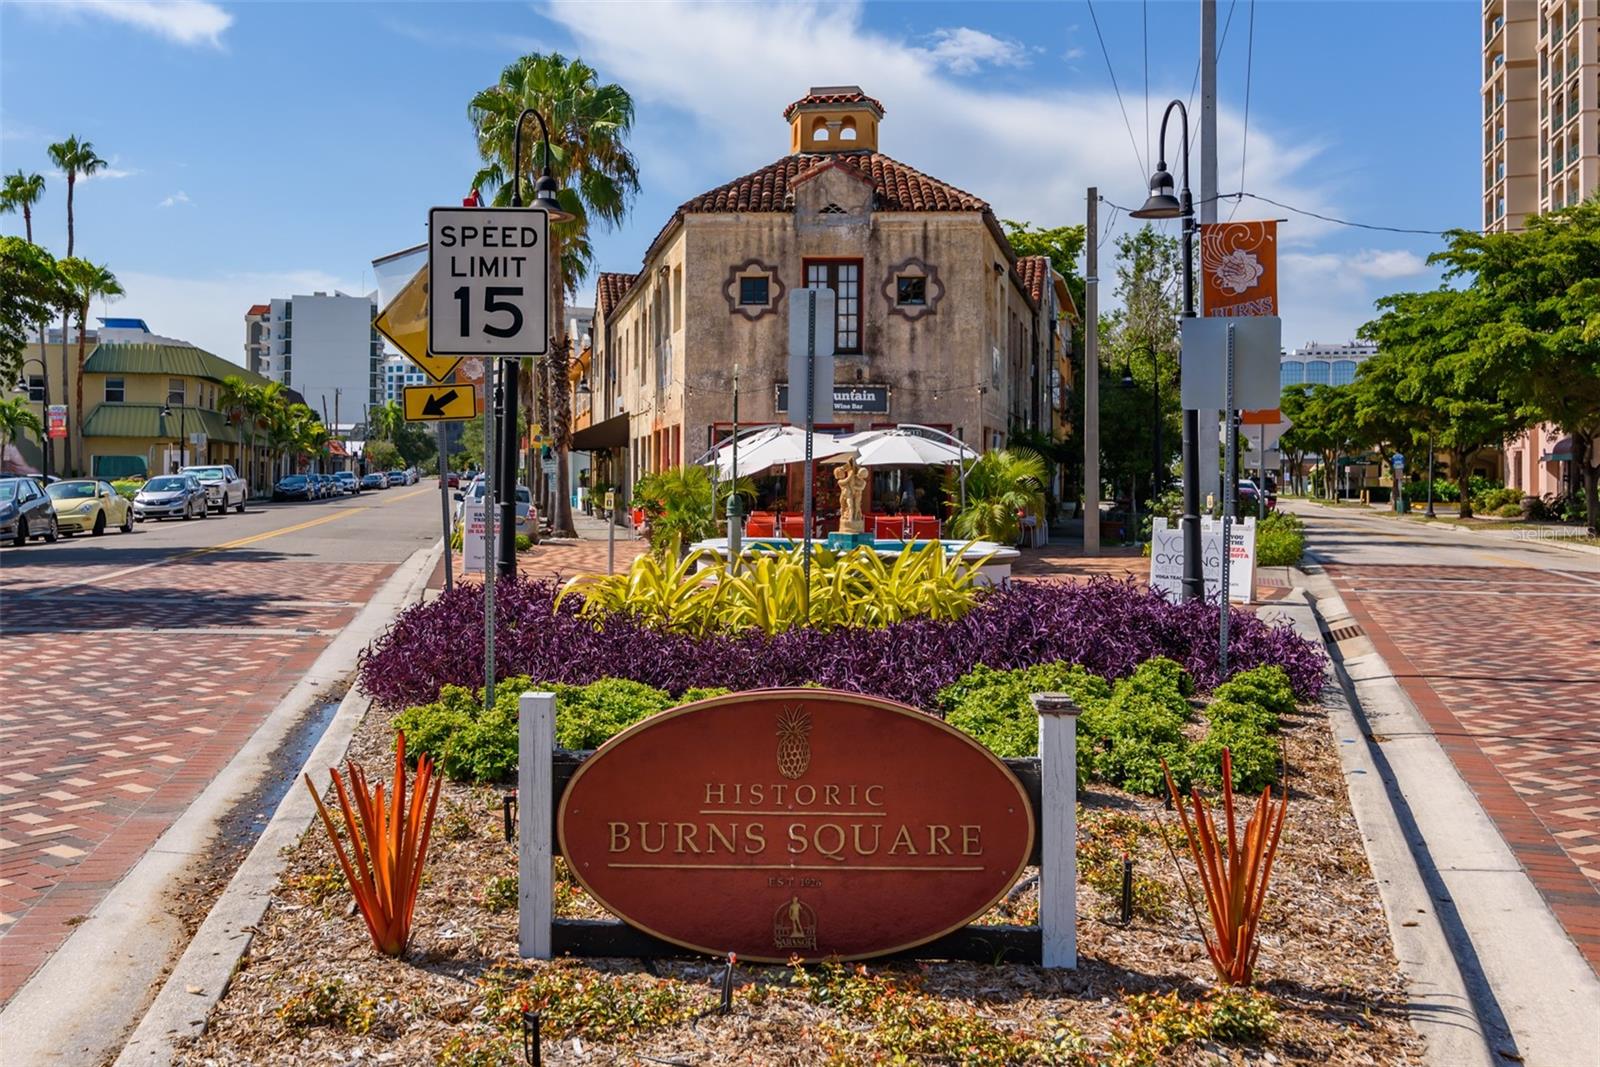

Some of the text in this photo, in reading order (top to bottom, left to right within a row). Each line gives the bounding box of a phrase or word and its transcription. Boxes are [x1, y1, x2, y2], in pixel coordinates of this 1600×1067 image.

[440, 226, 538, 248] SPEED
[451, 256, 527, 278] LIMIT
[454, 286, 524, 339] 15
[833, 390, 876, 401] untain
[1157, 536, 1220, 554] YOA
[1155, 553, 1220, 568] CYCNG
[704, 783, 884, 806] HISTORIC
[608, 822, 984, 861] BURNS SQUARE
[799, 877, 823, 889] 1926
